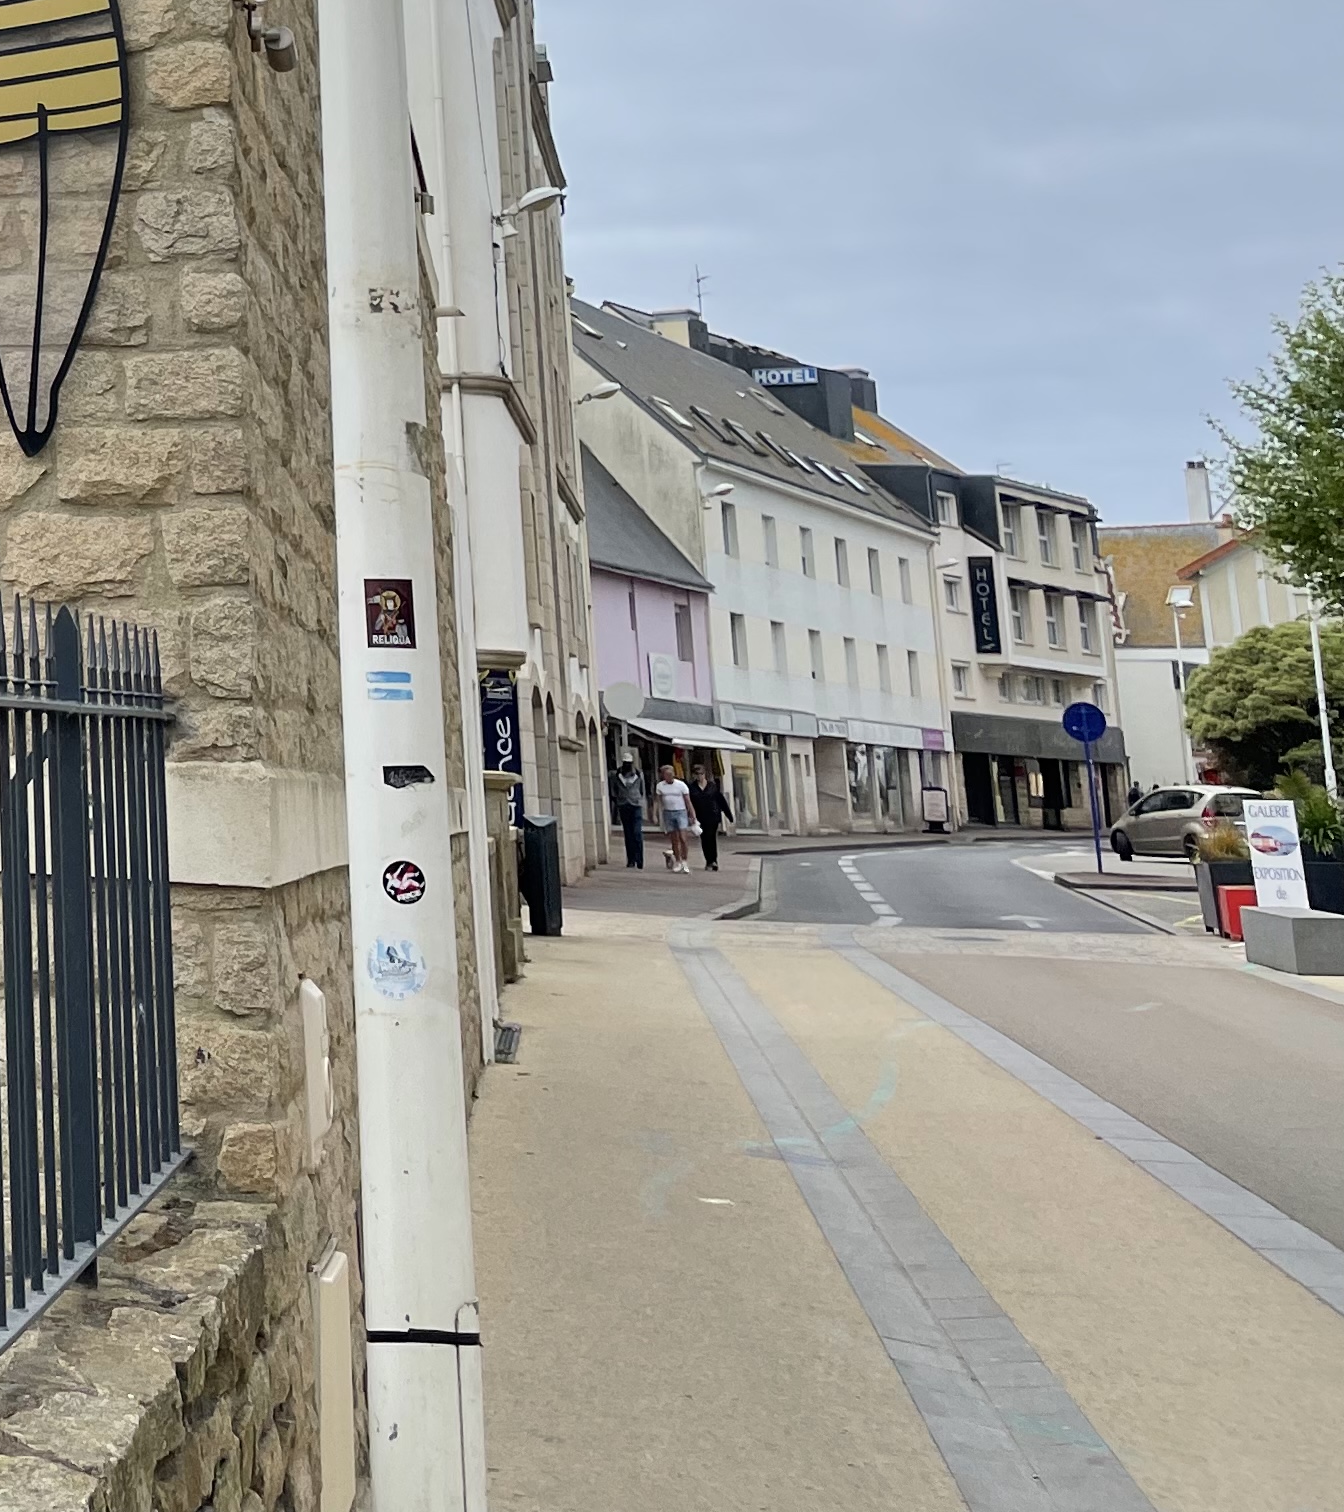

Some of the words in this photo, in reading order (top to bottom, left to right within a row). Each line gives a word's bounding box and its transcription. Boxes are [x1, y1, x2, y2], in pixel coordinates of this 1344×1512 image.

[753, 368, 817, 386] HOTEL
[975, 568, 993, 642] HOTEL
[1248, 804, 1291, 818] GALERIE
[1254, 867, 1303, 881] EXPOSITION
